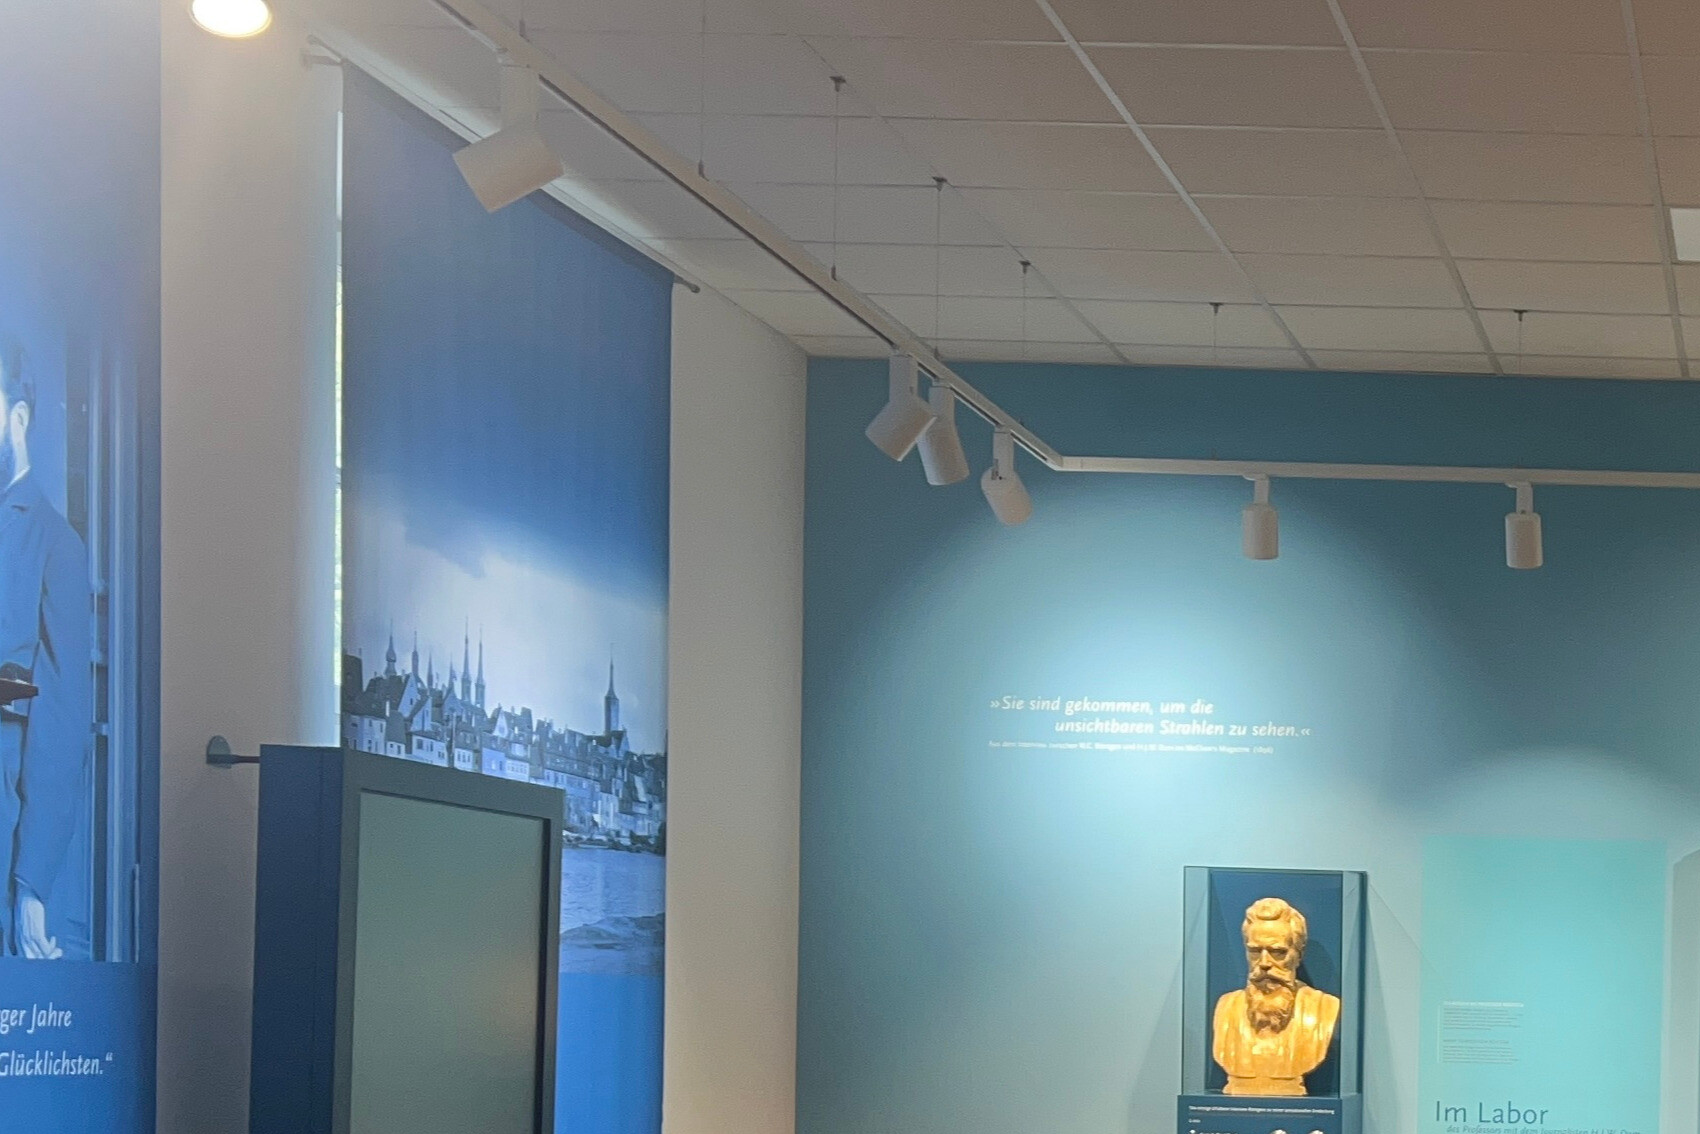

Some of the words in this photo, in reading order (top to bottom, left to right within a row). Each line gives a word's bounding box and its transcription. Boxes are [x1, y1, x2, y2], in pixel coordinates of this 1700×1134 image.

[1030, 696, 1060, 710] sind
[1064, 696, 1153, 716] gekommen,
[1160, 701, 1186, 714] um
[1190, 699, 1214, 714] die
[1055, 717, 1154, 734] unsichtbaren
[1159, 719, 1224, 736] Strahlen
[1228, 724, 1247, 736] zu
[26, 1002, 72, 1034] Jahre
[1435, 1100, 1467, 1122] Im
[1479, 1100, 1549, 1125] Labor
[1447, 1125, 1460, 1134] des
[1503, 1127, 1518, 1134] mit
[1520, 1127, 1538, 1134] dem
